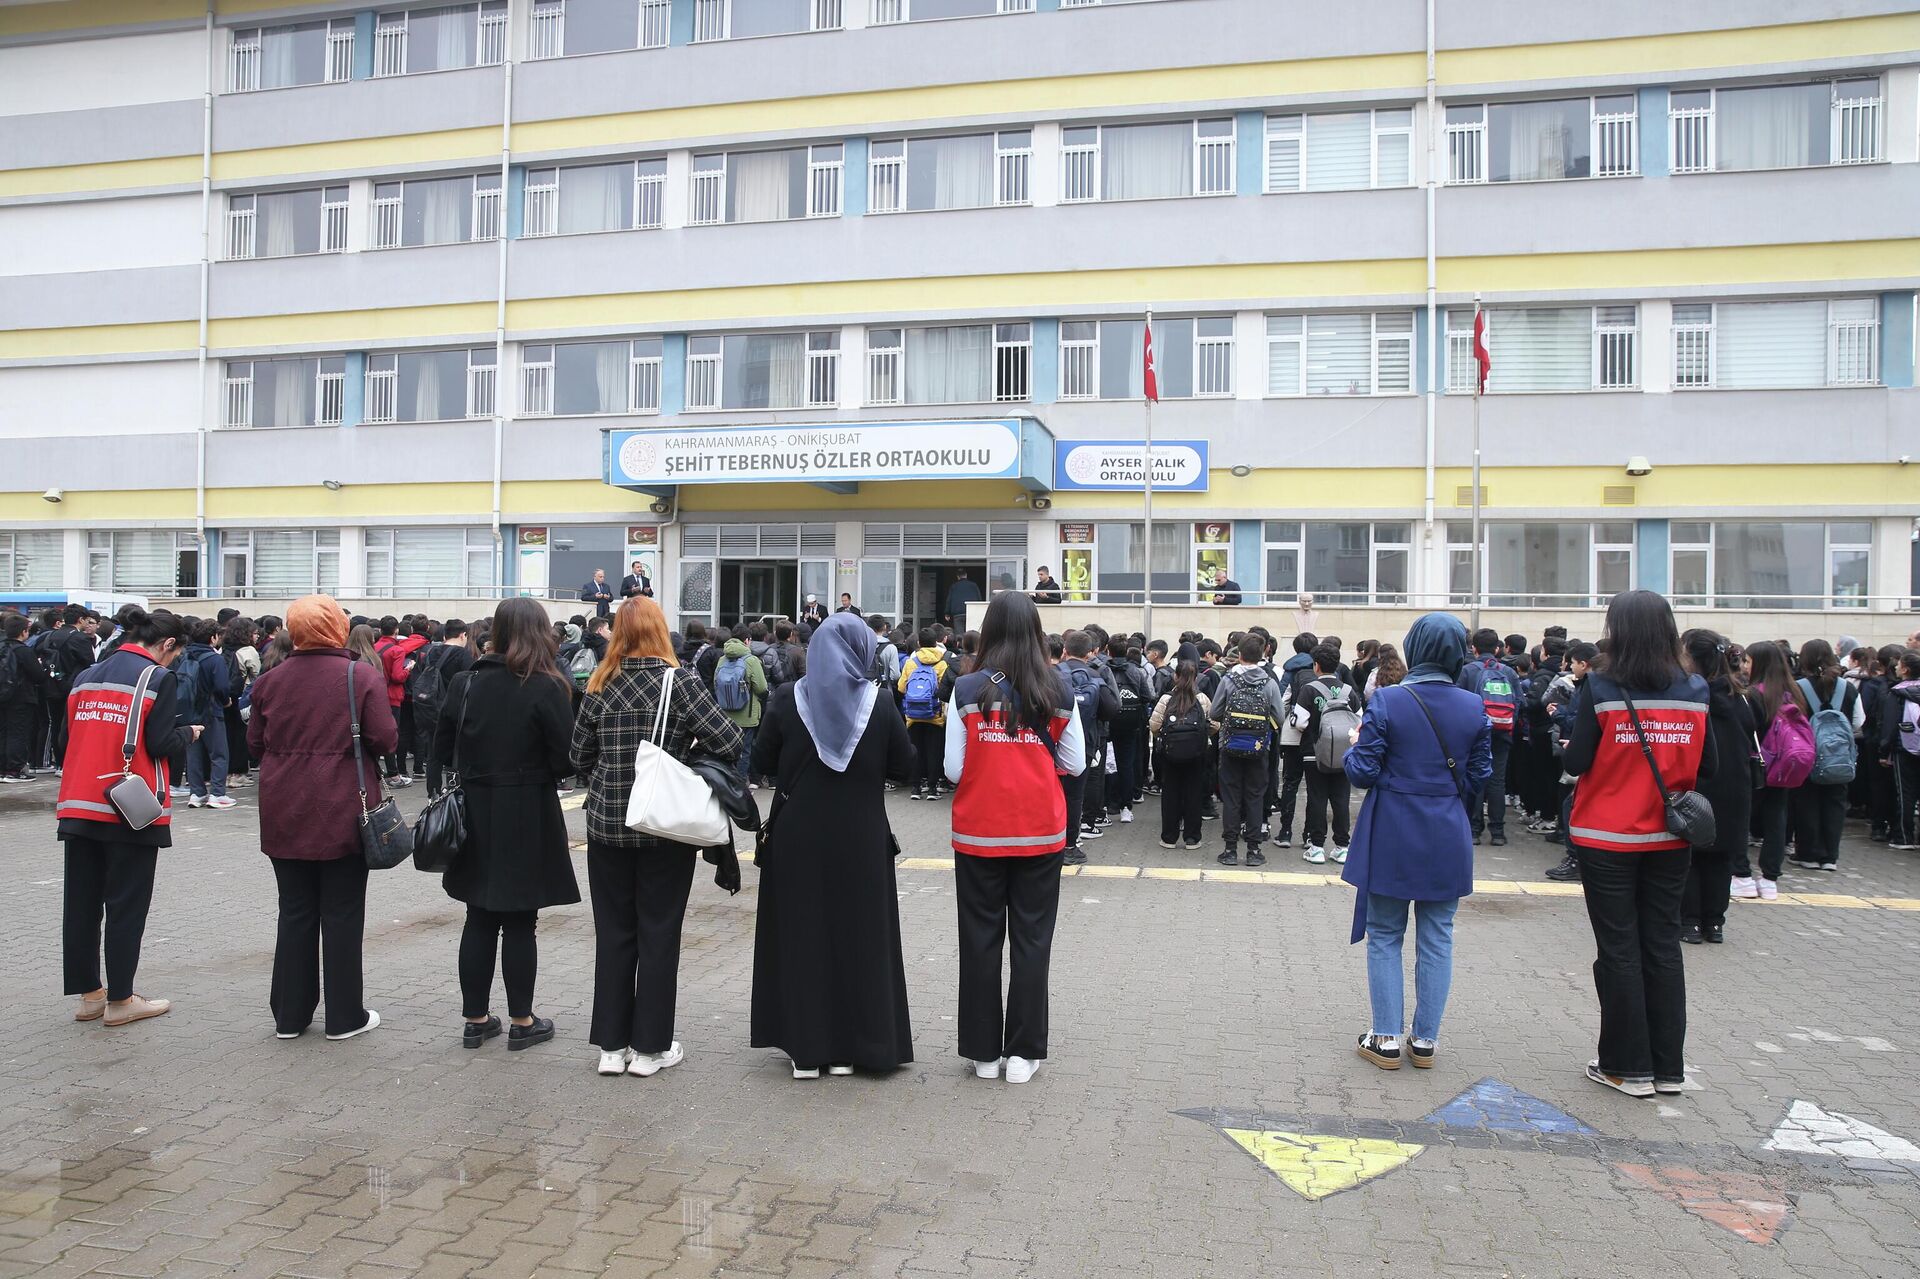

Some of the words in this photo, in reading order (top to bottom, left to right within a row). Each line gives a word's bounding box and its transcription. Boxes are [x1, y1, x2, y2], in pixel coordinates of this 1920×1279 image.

[665, 435, 777, 449] KAHRAMANMARAŞ
[787, 431, 862, 448] ONİKİŞUBAT
[665, 452, 714, 476] ŞEHİT
[717, 453, 809, 473] TEBERNUŞ
[813, 449, 872, 469] ÖZLER
[876, 449, 991, 468] ORTAOKULU
[1100, 458, 1142, 468] AYSER
[1149, 458, 1186, 468] ALIK
[1064, 558, 1088, 581] 15
[1640, 720, 1662, 731] ĞİTİM
